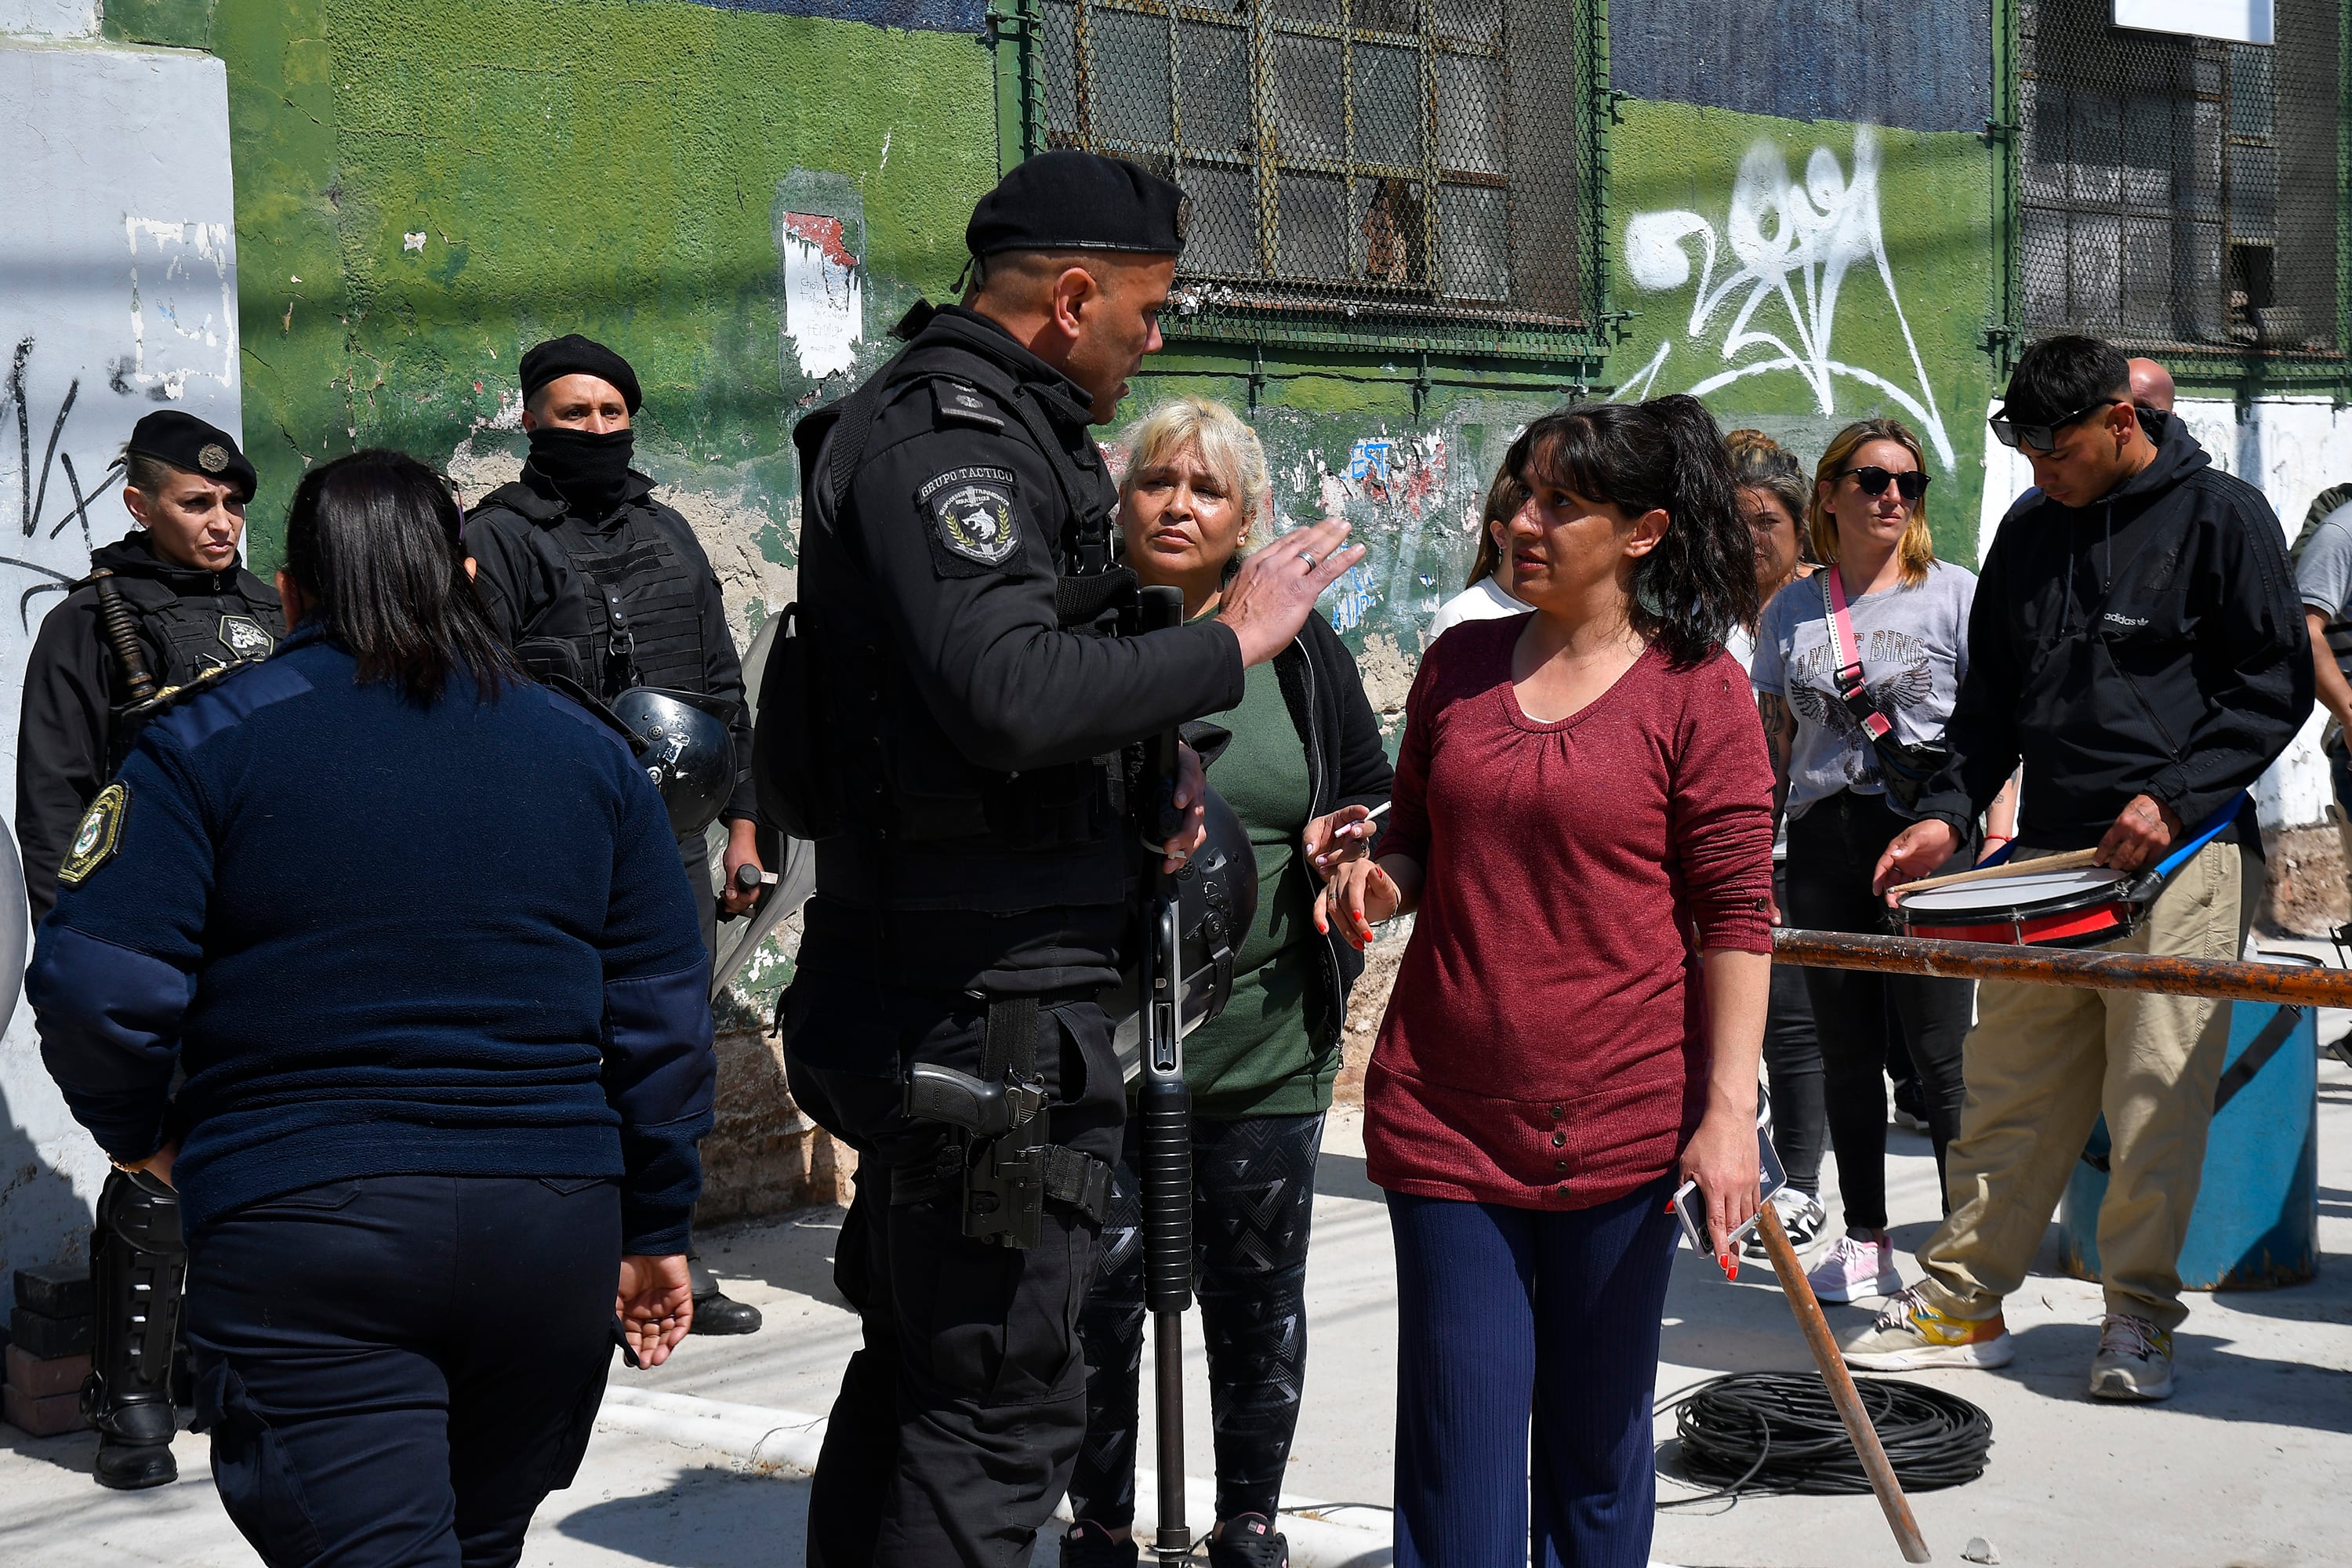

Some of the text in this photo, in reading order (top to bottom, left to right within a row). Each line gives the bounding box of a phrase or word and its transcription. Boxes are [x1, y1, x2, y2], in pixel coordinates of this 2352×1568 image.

[921, 468, 1013, 497] GRUPO TACTICO
[2103, 612, 2136, 626] adidas
[1869, 630, 1926, 669] BING
